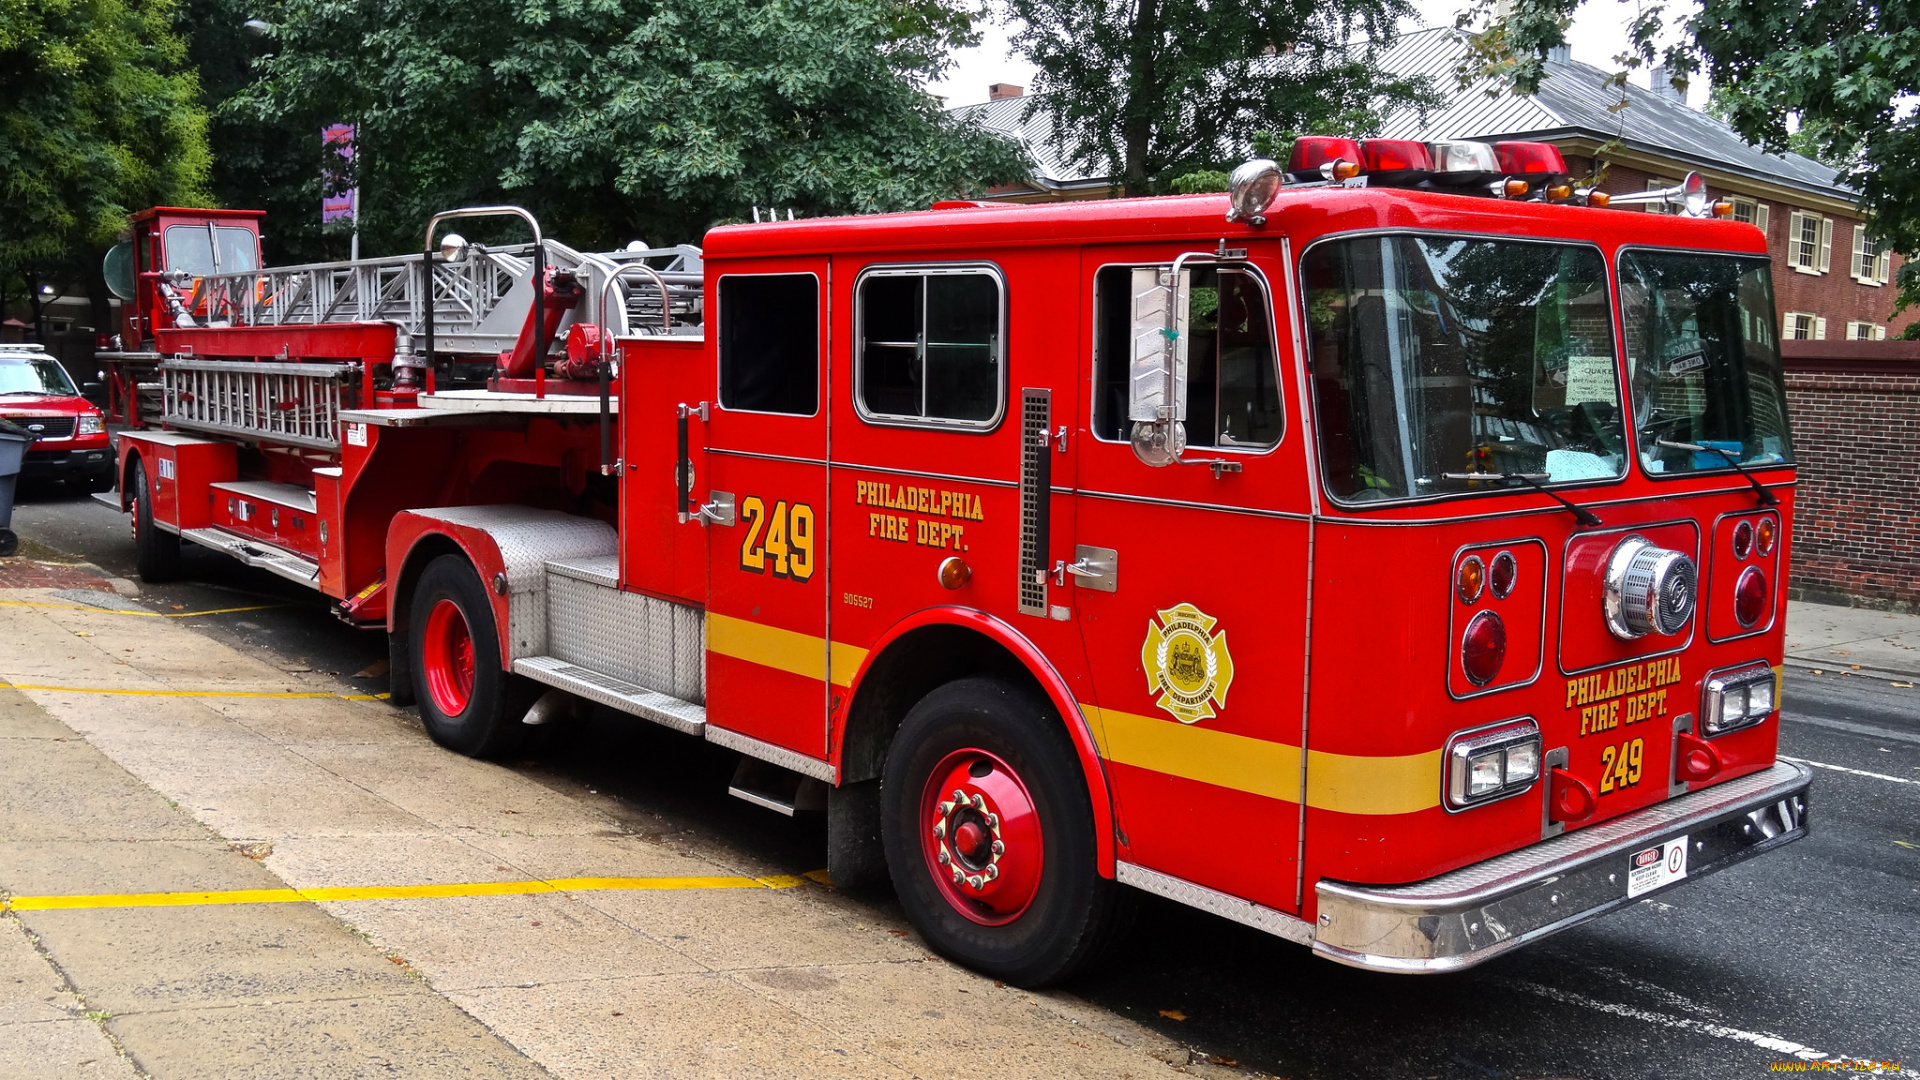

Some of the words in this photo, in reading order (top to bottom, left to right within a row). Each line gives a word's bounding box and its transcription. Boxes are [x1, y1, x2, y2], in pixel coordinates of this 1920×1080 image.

[856, 480, 984, 521] PHILADELPHIA
[741, 496, 814, 582] 249
[869, 513, 909, 542] FIRE
[916, 520, 969, 552] DEPT.
[843, 592, 874, 610] 905527
[1163, 622, 1210, 644] PHILADELPHIA
[1160, 674, 1170, 692] FIRE
[1172, 683, 1215, 705] DEPARTMENT
[1566, 657, 1681, 709] PHILADELPHIA
[1580, 700, 1619, 736] FIRE
[1625, 689, 1667, 724] DEPT.
[1600, 738, 1644, 795] 249
